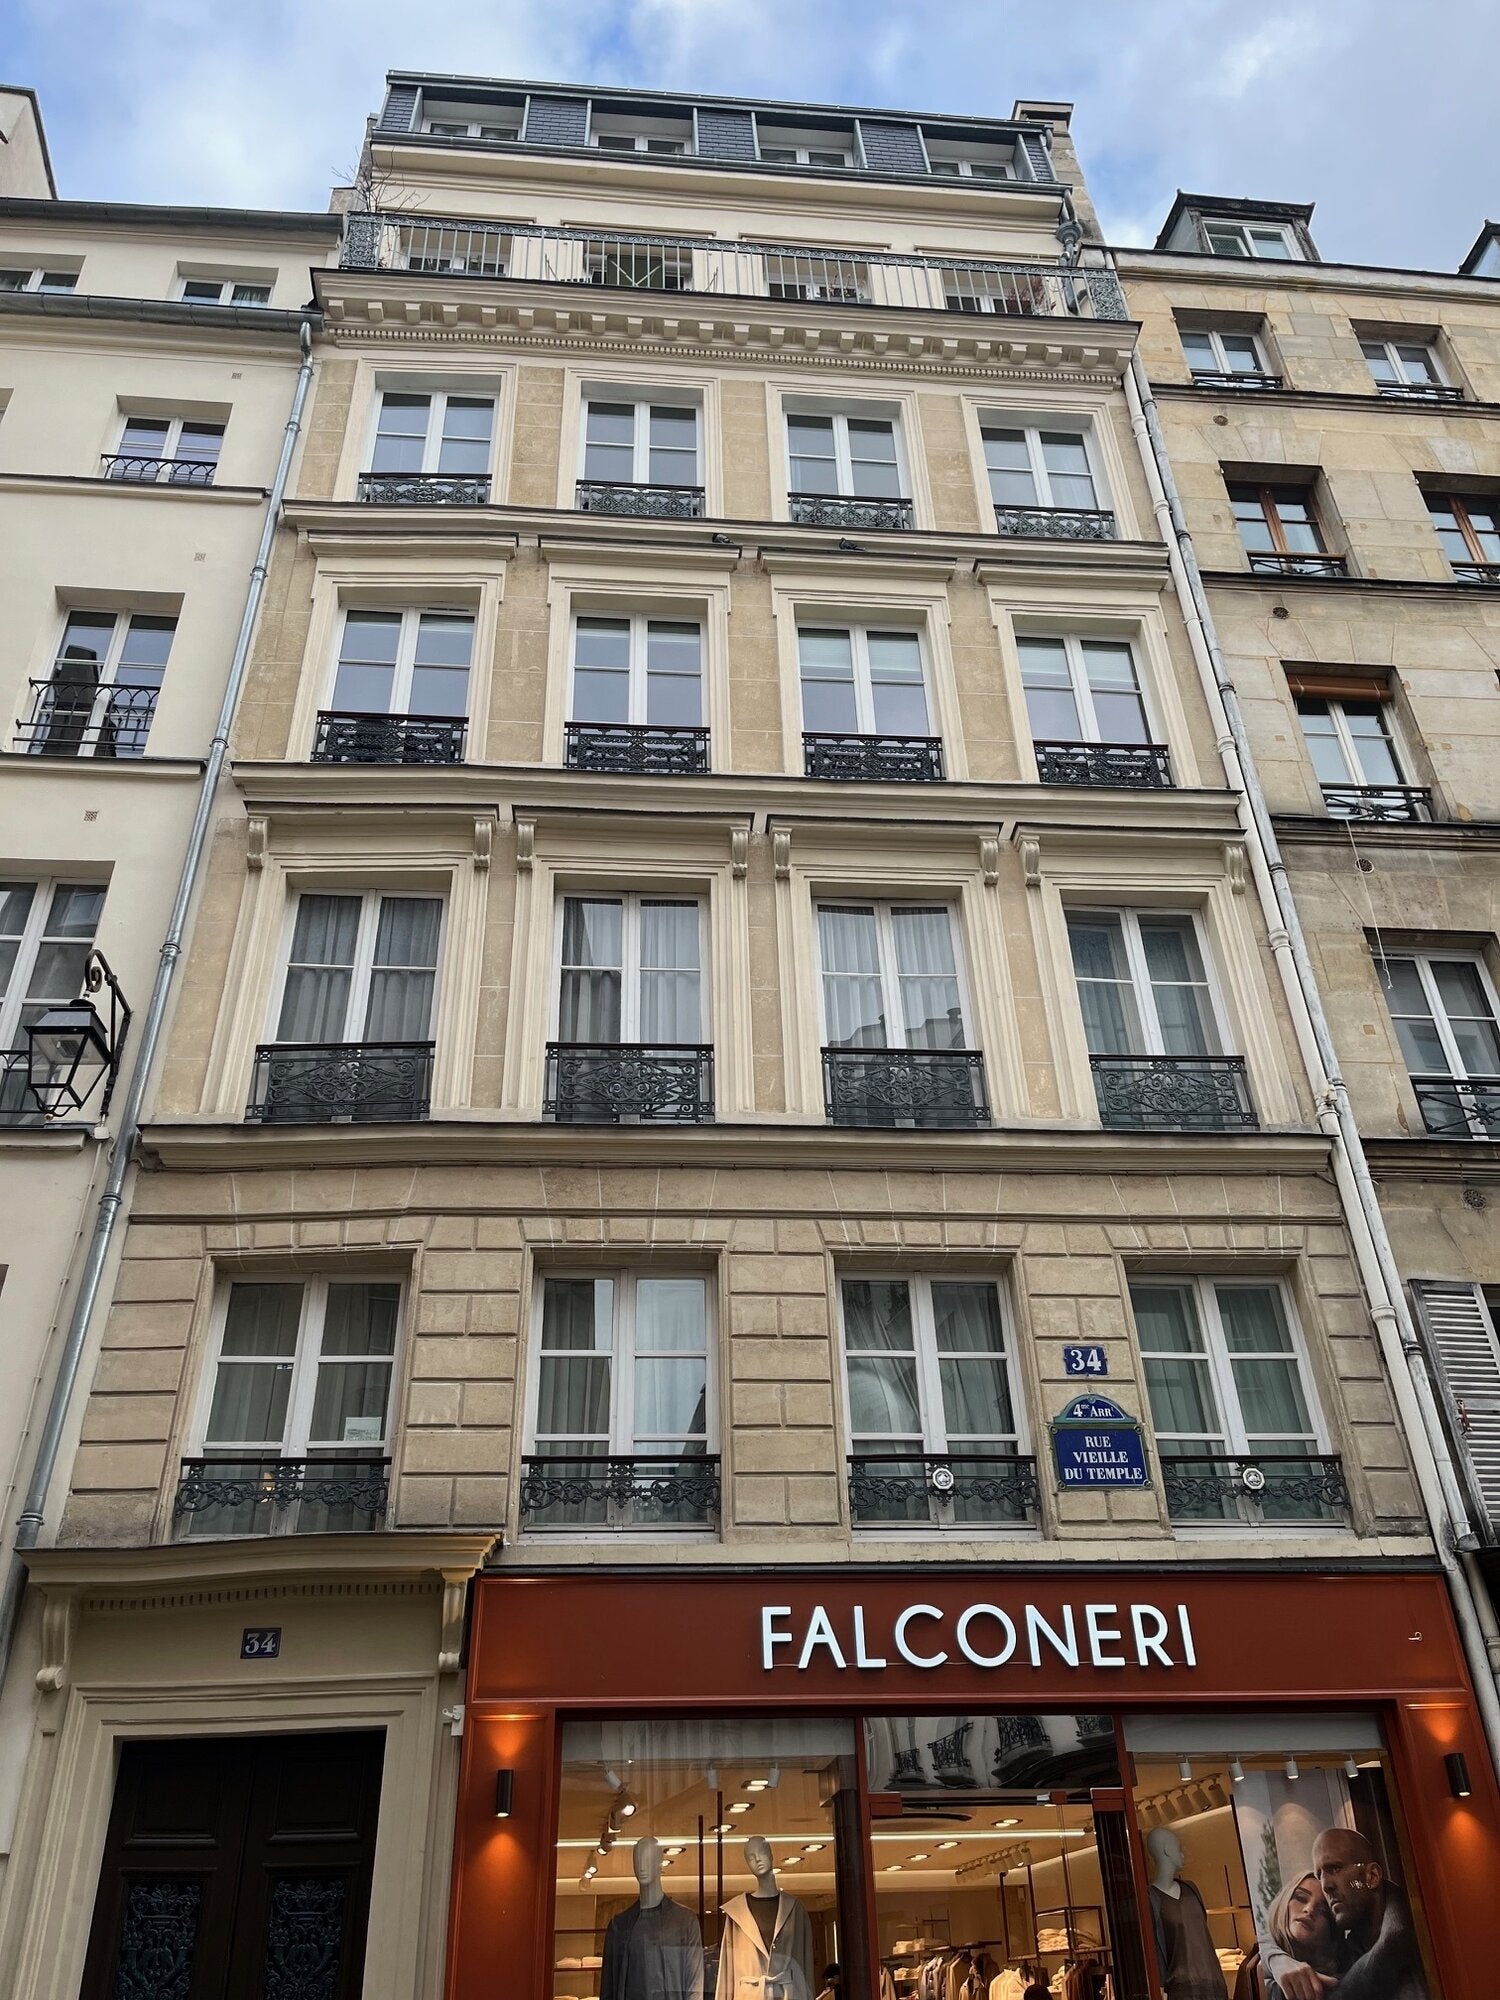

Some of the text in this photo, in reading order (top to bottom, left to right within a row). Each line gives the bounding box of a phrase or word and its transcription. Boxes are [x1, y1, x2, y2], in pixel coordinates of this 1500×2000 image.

[1070, 1349, 1102, 1371] 34
[1084, 1436, 1112, 1448] RUE
[1073, 1451, 1129, 1463] VIEILLE
[1064, 1467, 1143, 1480] DU TEMPLE
[245, 1632, 277, 1654] 34
[761, 1603, 1197, 1670] FALCONERI
